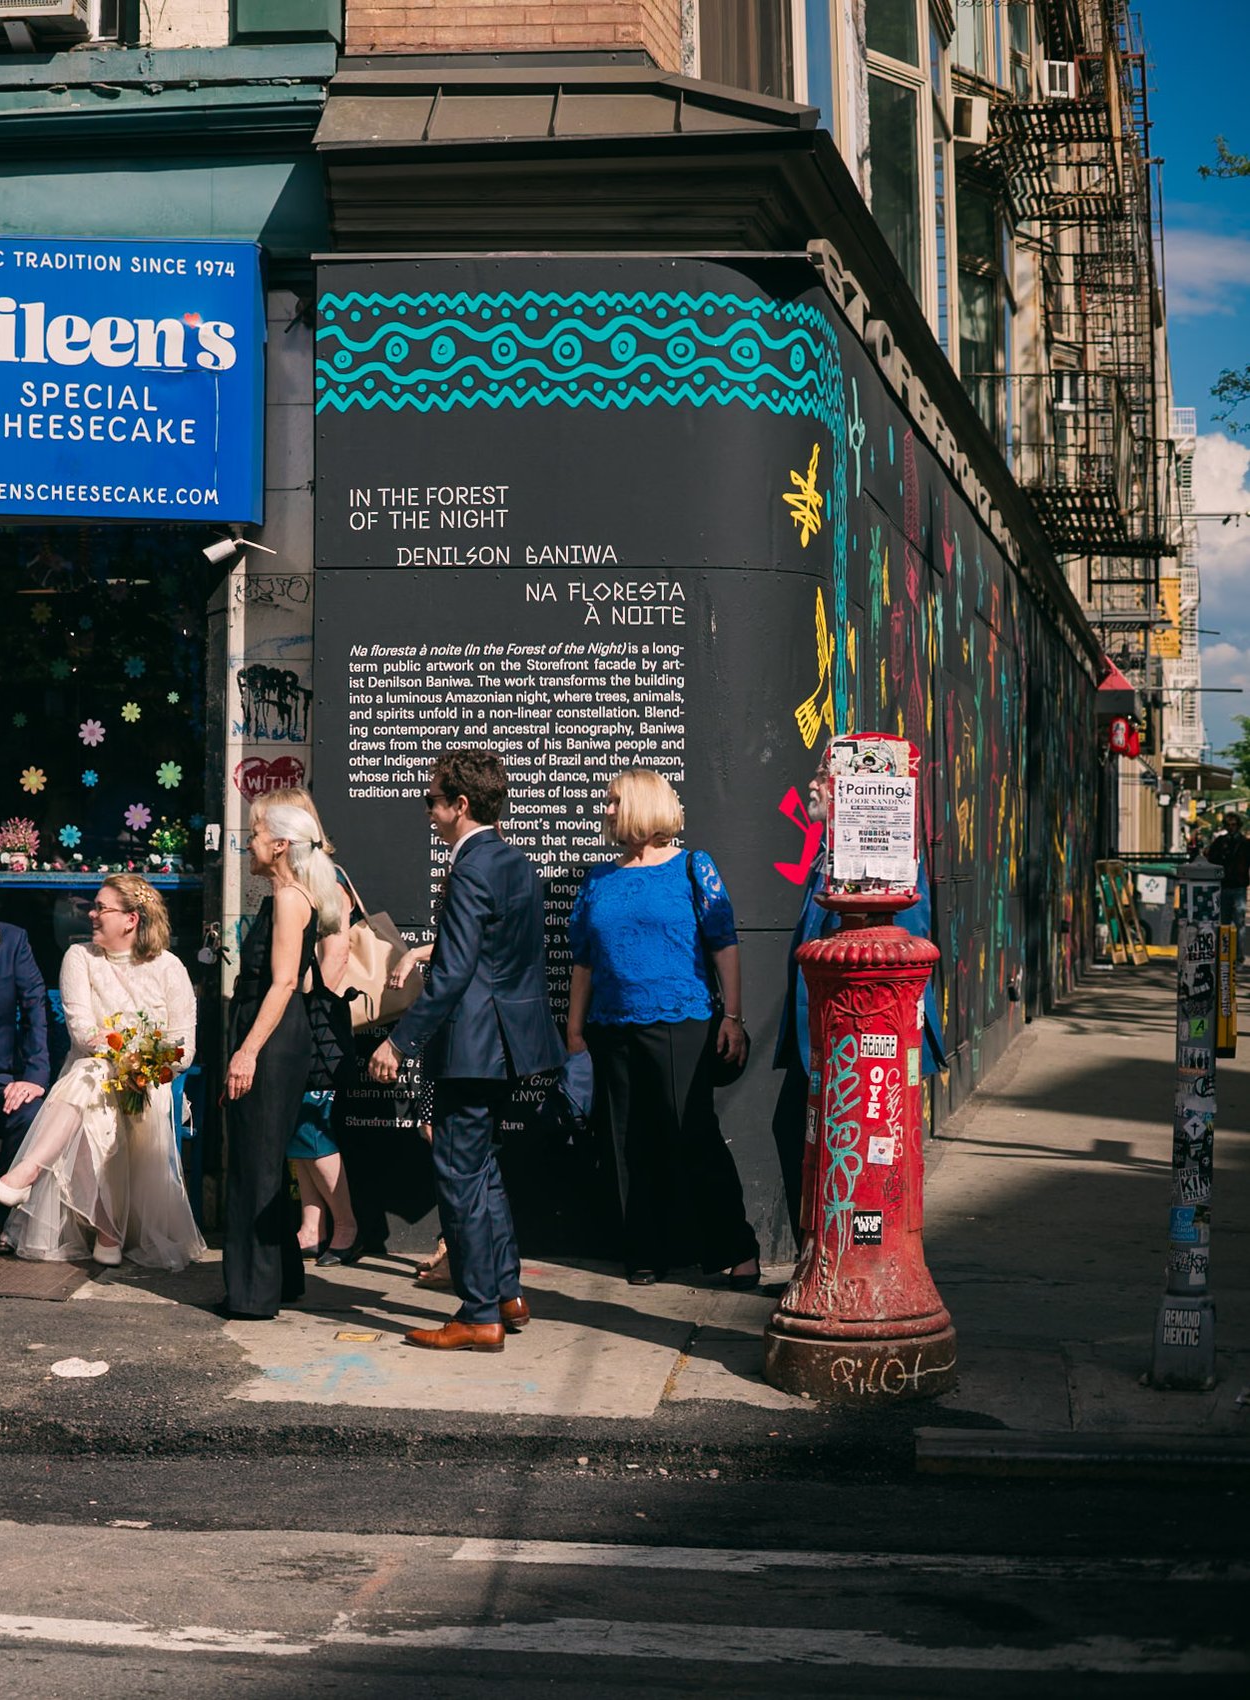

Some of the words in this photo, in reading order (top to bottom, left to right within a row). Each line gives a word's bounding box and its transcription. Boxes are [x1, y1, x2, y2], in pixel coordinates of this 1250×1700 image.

[14, 252, 121, 272] TRADITION
[131, 258, 187, 274] SINCE
[195, 260, 236, 277] 1974
[20, 381, 158, 412] SPECIAL
[349, 488, 371, 507] IN
[378, 487, 419, 506] THE
[426, 486, 509, 506] FOREST
[349, 512, 378, 531] OF
[389, 511, 430, 530] THE
[440, 509, 508, 529] NIGHT
[397, 546, 510, 566] DENILSON
[526, 545, 618, 565] BANIWA
[526, 582, 556, 602] NA
[568, 582, 685, 601] FLORESTA
[611, 606, 685, 625] NOITE
[349, 645, 369, 657] Na
[370, 645, 417, 657] floresta
[418, 644, 428, 657] à
[429, 643, 463, 656] noite
[464, 643, 481, 657] (In
[482, 643, 505, 656] the
[505, 643, 547, 656] Forest
[547, 643, 564, 655] of
[564, 643, 586, 655] the
[587, 643, 628, 657] Night)
[628, 643, 639, 655] is
[641, 645, 650, 655] a
[652, 642, 685, 657] long-
[348, 662, 378, 673] term
[383, 660, 422, 676] public
[425, 659, 475, 672] artwork
[478, 662, 496, 672] on
[500, 659, 522, 672] the
[526, 659, 590, 672] Storefront
[593, 657, 637, 671] facade
[641, 658, 658, 673] by
[662, 659, 685, 670] art-
[349, 677, 365, 689] ist
[367, 676, 423, 689] Denilson
[425, 675, 474, 688] Baniwa.
[476, 675, 501, 687] The
[503, 675, 536, 687] work
[538, 674, 607, 688] transforms
[609, 674, 631, 686] the
[634, 674, 685, 689] building
[349, 693, 374, 705] into
[375, 695, 384, 705] a
[385, 692, 443, 704] luminous
[444, 692, 513, 704] Amazonian
[515, 690, 551, 705] night,
[553, 690, 593, 703] where
[594, 691, 630, 705] trees,
[632, 690, 685, 705] animals,
[348, 708, 373, 721] and
[376, 708, 415, 723] spirits
[418, 707, 458, 720] unfold
[461, 707, 474, 720] in
[477, 710, 486, 720] a
[489, 706, 553, 719] non-linear
[555, 706, 641, 719] constellation.
[644, 706, 685, 719] Blend-
[349, 724, 369, 739] ing
[372, 724, 460, 738] contemporary
[463, 723, 488, 735] and
[492, 722, 550, 735] ancestral
[554, 722, 635, 737] iconography,
[639, 722, 685, 735] Baniwa
[348, 739, 386, 752] draws
[389, 739, 418, 752] from
[421, 739, 443, 752] the
[445, 739, 524, 754] cosmologies
[526, 738, 541, 750] of
[543, 738, 563, 751] his
[566, 738, 611, 751] Baniwa
[614, 738, 658, 754] people
[660, 738, 685, 750] and
[349, 755, 381, 766] other
[534, 754, 546, 766] of
[549, 754, 581, 766] Brazil
[584, 754, 607, 765] and
[609, 754, 630, 765] the
[632, 754, 684, 767] Amazon,
[349, 771, 389, 782] whose
[392, 771, 415, 782] rich
[549, 770, 590, 783] dance,
[349, 786, 399, 798] tradition
[402, 789, 421, 798] are
[548, 786, 560, 798] of
[563, 786, 587, 798] loss
[846, 784, 904, 798] Painting
[510, 802, 567, 814] becomes
[556, 819, 601, 832] moving
[867, 1066, 884, 1119] OYE
[1165, 1310, 1199, 1327] REMAND
[1163, 1327, 1199, 1345] HEKTIC
